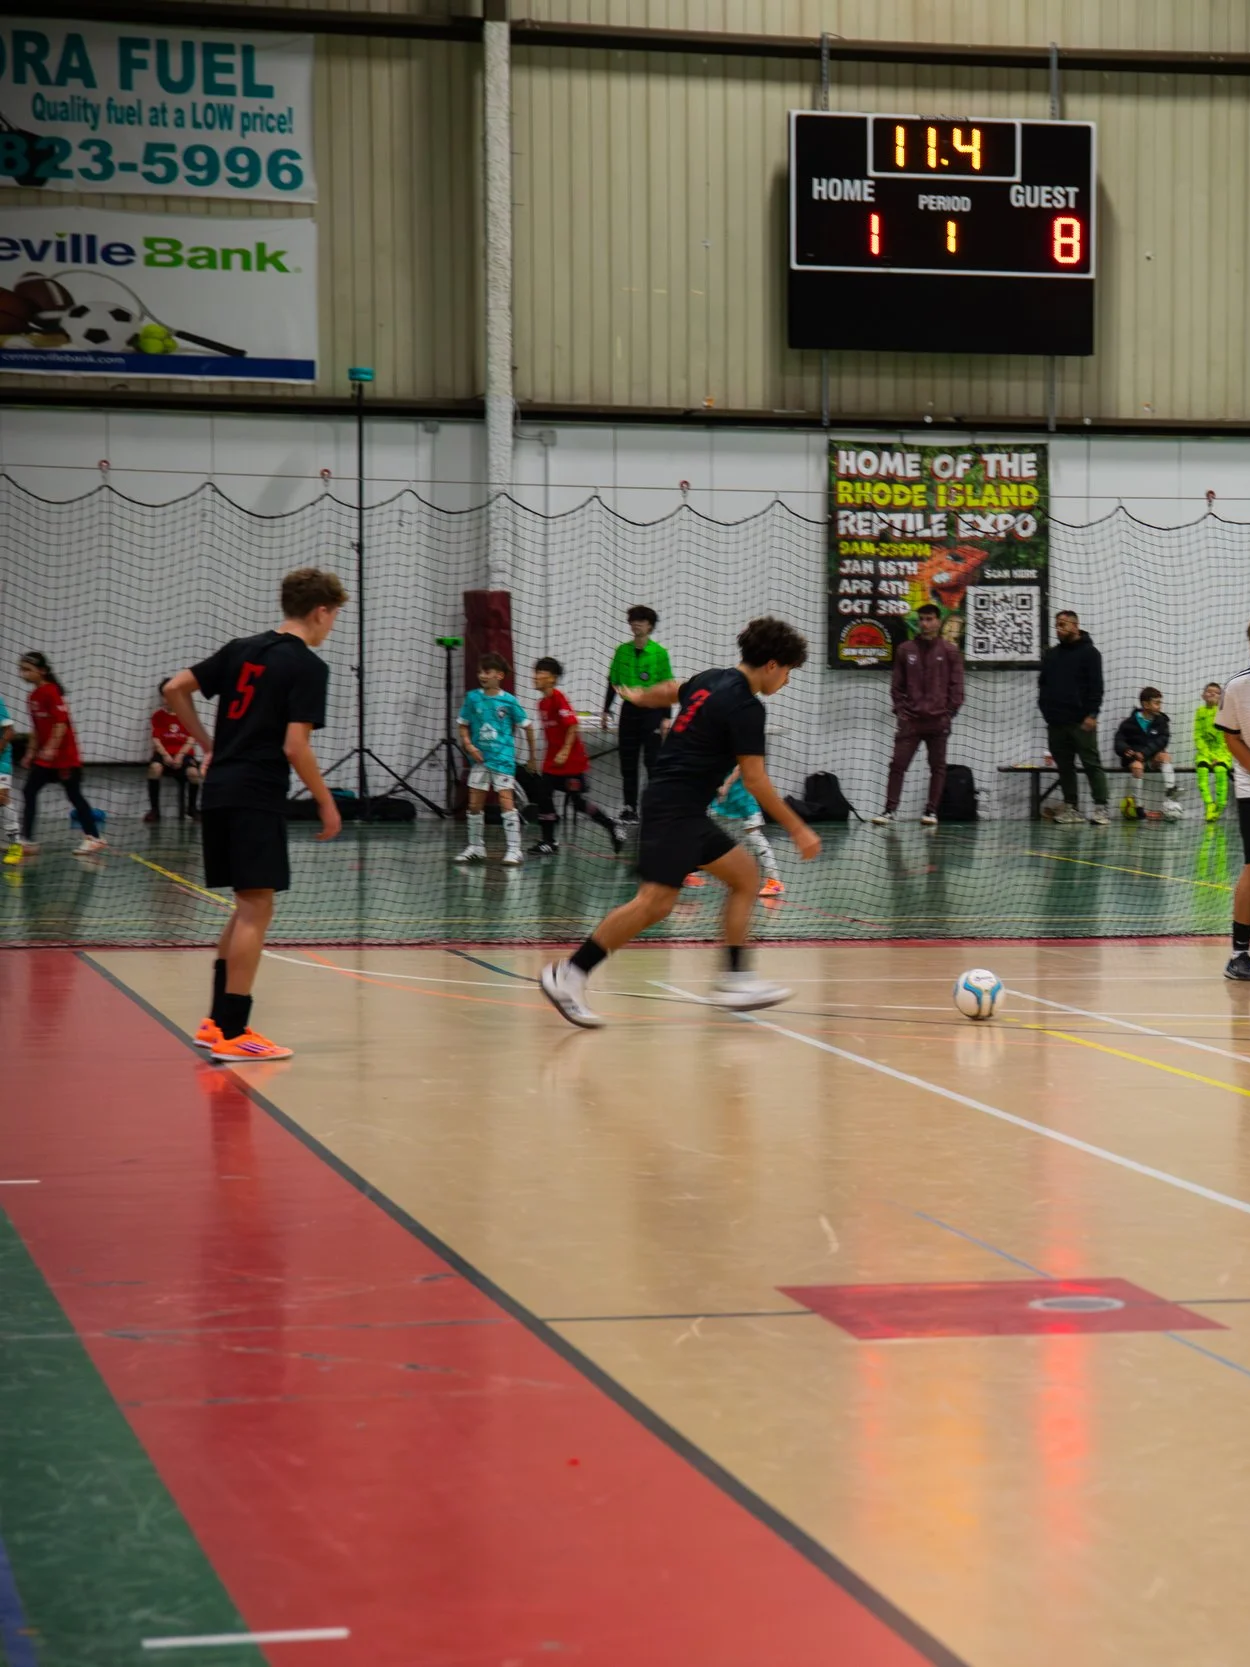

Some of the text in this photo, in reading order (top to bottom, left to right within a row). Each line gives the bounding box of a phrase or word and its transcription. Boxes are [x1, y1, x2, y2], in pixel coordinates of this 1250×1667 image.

[0, 29, 274, 98] RA FUEL
[32, 92, 293, 139] Quality fuel at a LOW price!
[895, 124, 981, 170] 11.4
[811, 177, 876, 202] HOME
[918, 193, 972, 212] PERIOD
[1009, 184, 1080, 208] GUEST
[870, 212, 880, 255] 1
[946, 219, 957, 253] 1
[1053, 216, 1081, 264] 8
[143, 236, 290, 273] Bank
[838, 450, 1038, 479] HOME OF THE
[837, 480, 1040, 509] RHODE ISLAND
[837, 510, 1038, 538] REPTILE EXPO
[839, 560, 875, 575] JAN
[839, 579, 909, 596] APR 4TH
[838, 599, 912, 615] OCT 3RD
[227, 661, 266, 720] 5
